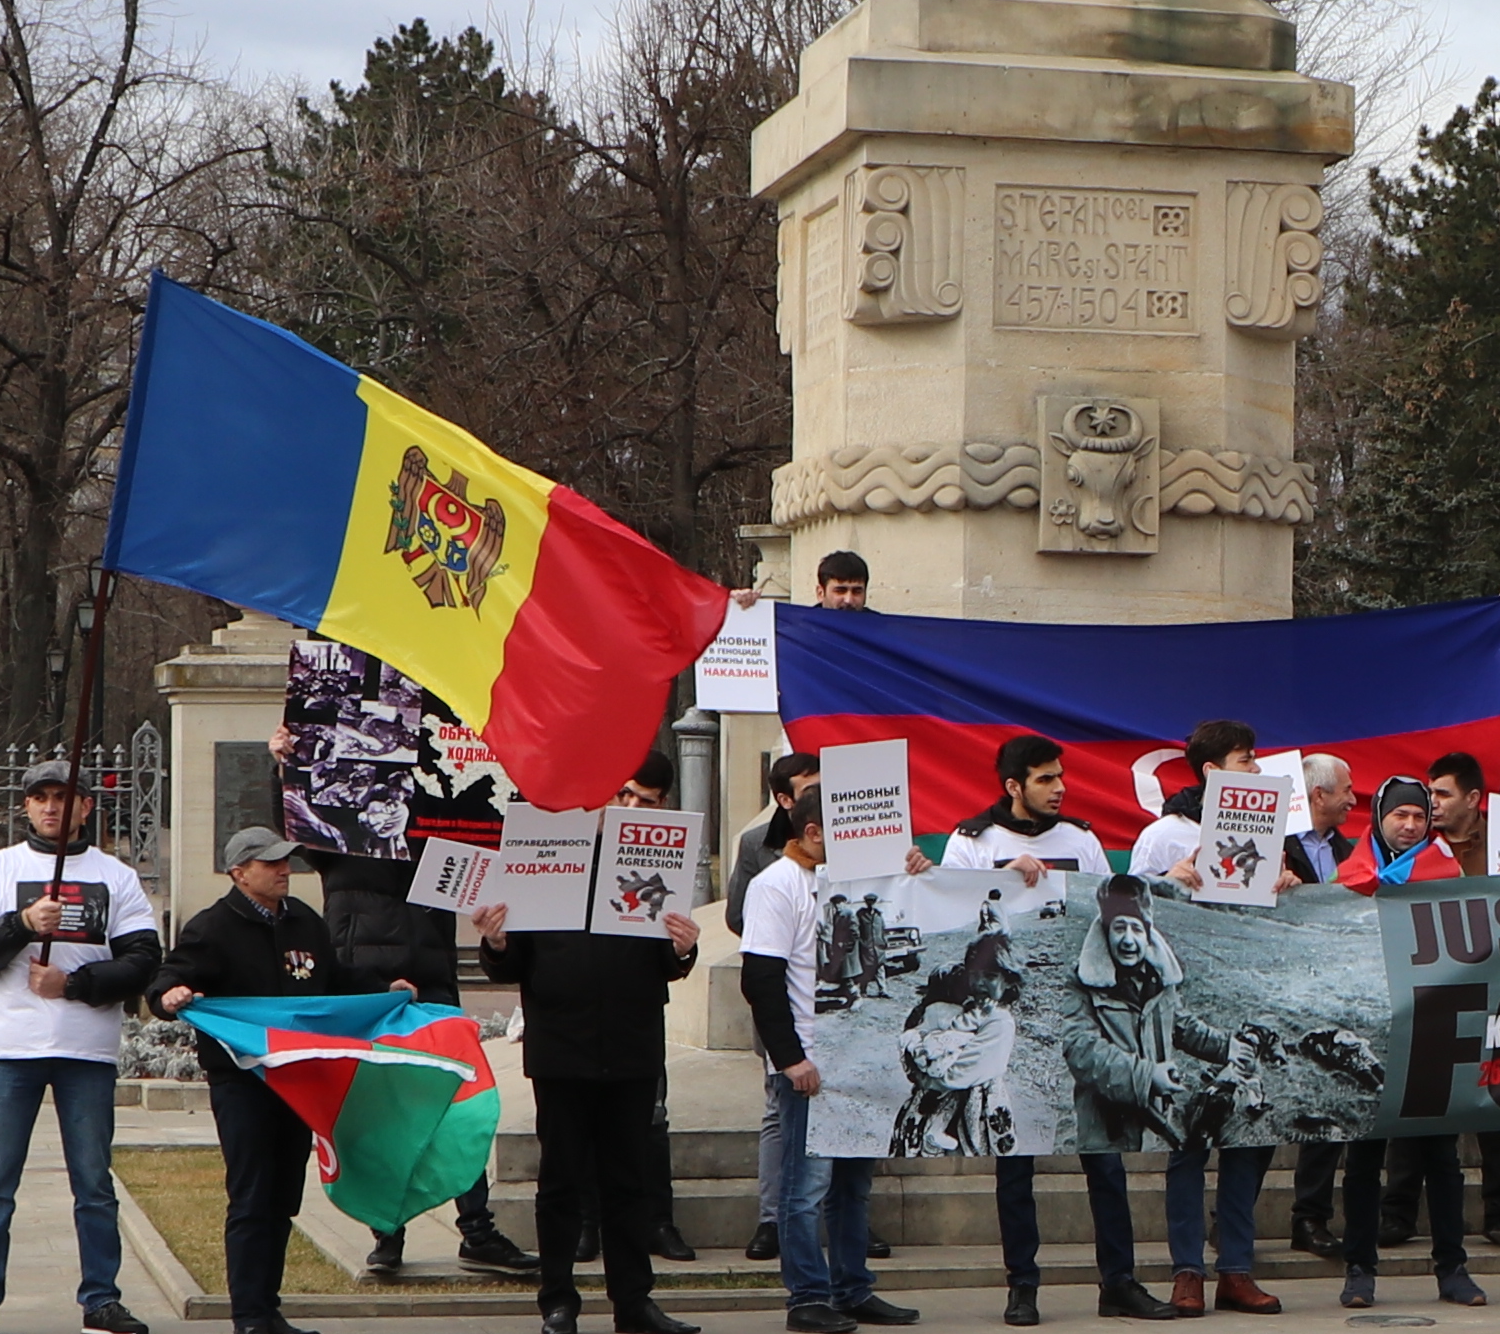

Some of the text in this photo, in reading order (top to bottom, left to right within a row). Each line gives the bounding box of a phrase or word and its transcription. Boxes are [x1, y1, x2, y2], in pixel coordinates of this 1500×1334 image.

[998, 238, 1081, 279] MARE
[717, 647, 762, 656] ГЕНОЦИДЕ
[702, 656, 769, 666] ДОЛЖНЫ БЫТЬ
[703, 667, 769, 679] НАКАЗАНЫ
[438, 725, 483, 742] ОБРЕ
[446, 746, 498, 763] ХОДЖА
[830, 785, 901, 803] ВИНОВНЫЕ
[1221, 788, 1276, 810] STOP
[838, 799, 894, 814] В ГЕНОЦИДЕ
[831, 810, 903, 828] ДОЛЖНЫ БЫТЬ
[1216, 810, 1276, 824] ARMENIAN
[621, 825, 684, 846] STOP
[833, 823, 903, 842] НАКАЗАНЫ
[1215, 821, 1274, 835] AGRESSION
[505, 839, 592, 848] СПРАВЕДЛИВОСТЬ
[536, 850, 557, 859] ДЛЯ
[616, 846, 685, 859] ARMENIAN
[504, 862, 586, 876] ХОДЖАЛЫ
[615, 857, 683, 870] AGRESSION
[450, 857, 469, 898] ПРИЗНАЙ
[466, 857, 492, 906] ГЕНОЦИД
